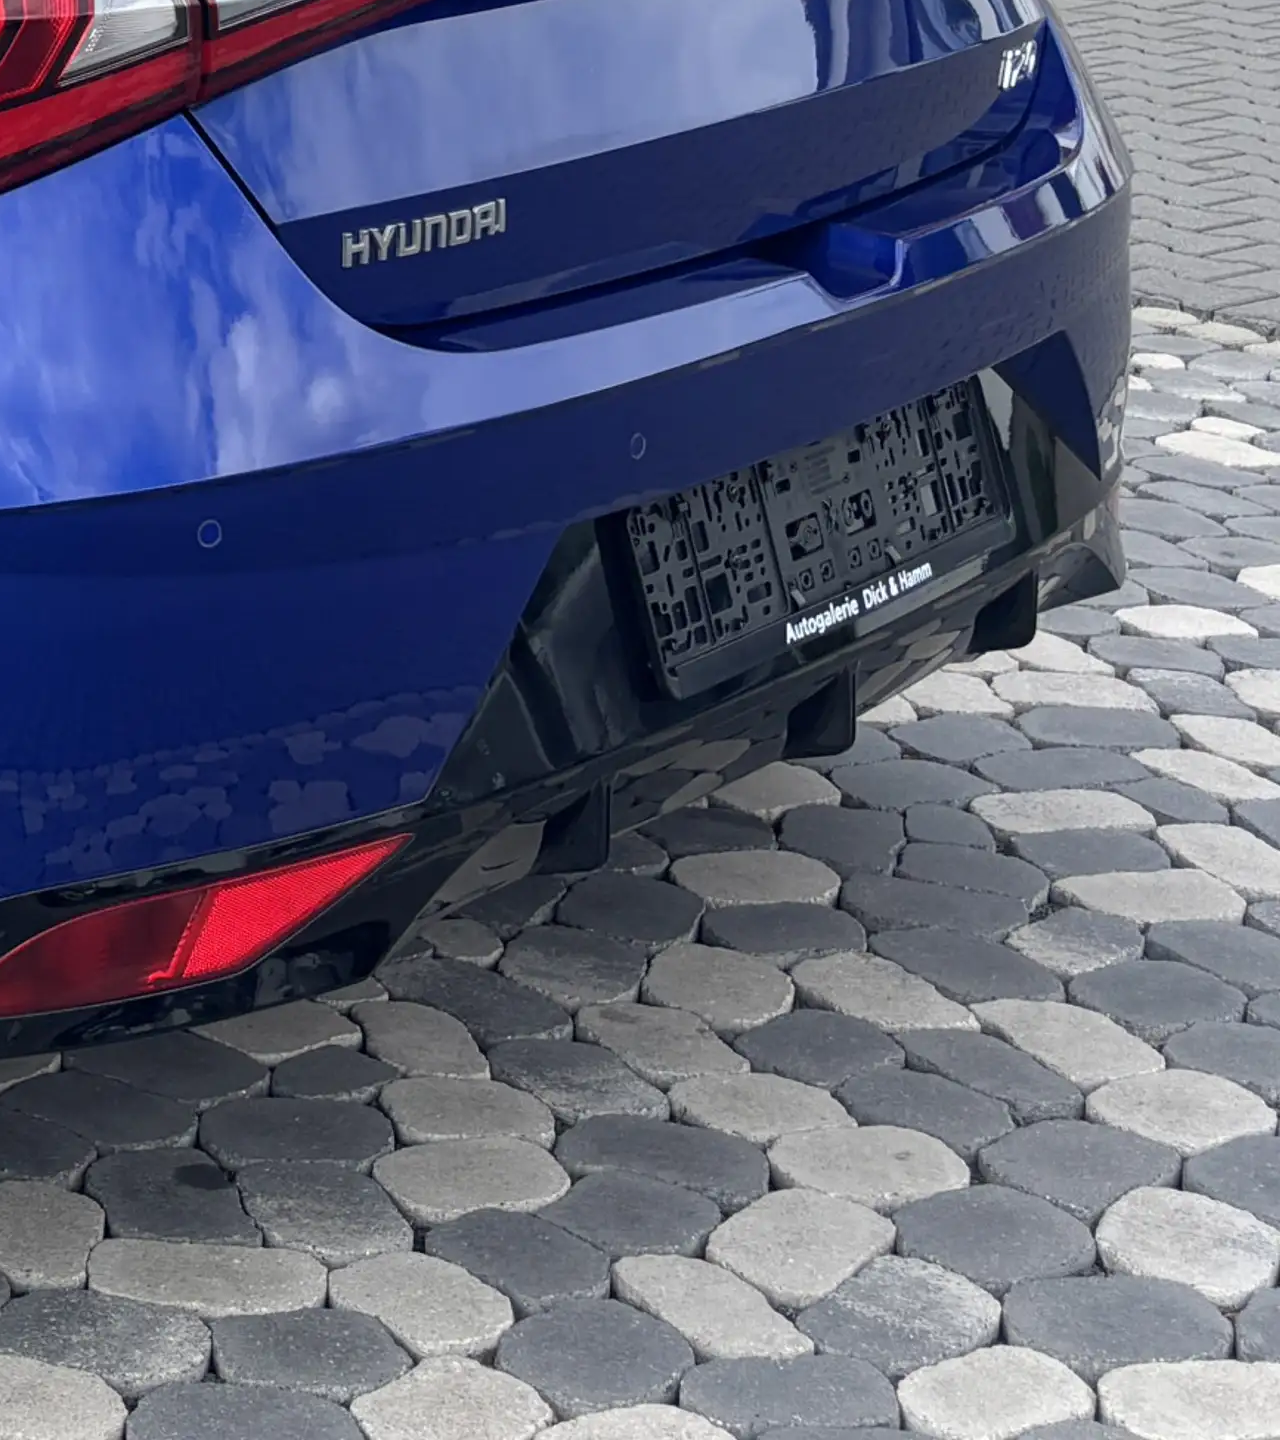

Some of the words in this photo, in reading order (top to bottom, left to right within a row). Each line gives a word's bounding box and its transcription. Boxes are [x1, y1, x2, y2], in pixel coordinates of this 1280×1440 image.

[340, 197, 507, 268] HYUNDAI
[786, 597, 860, 644] Autogalerie
[862, 580, 889, 610] Dick
[888, 575, 899, 597] &
[898, 562, 933, 592] Hamm
